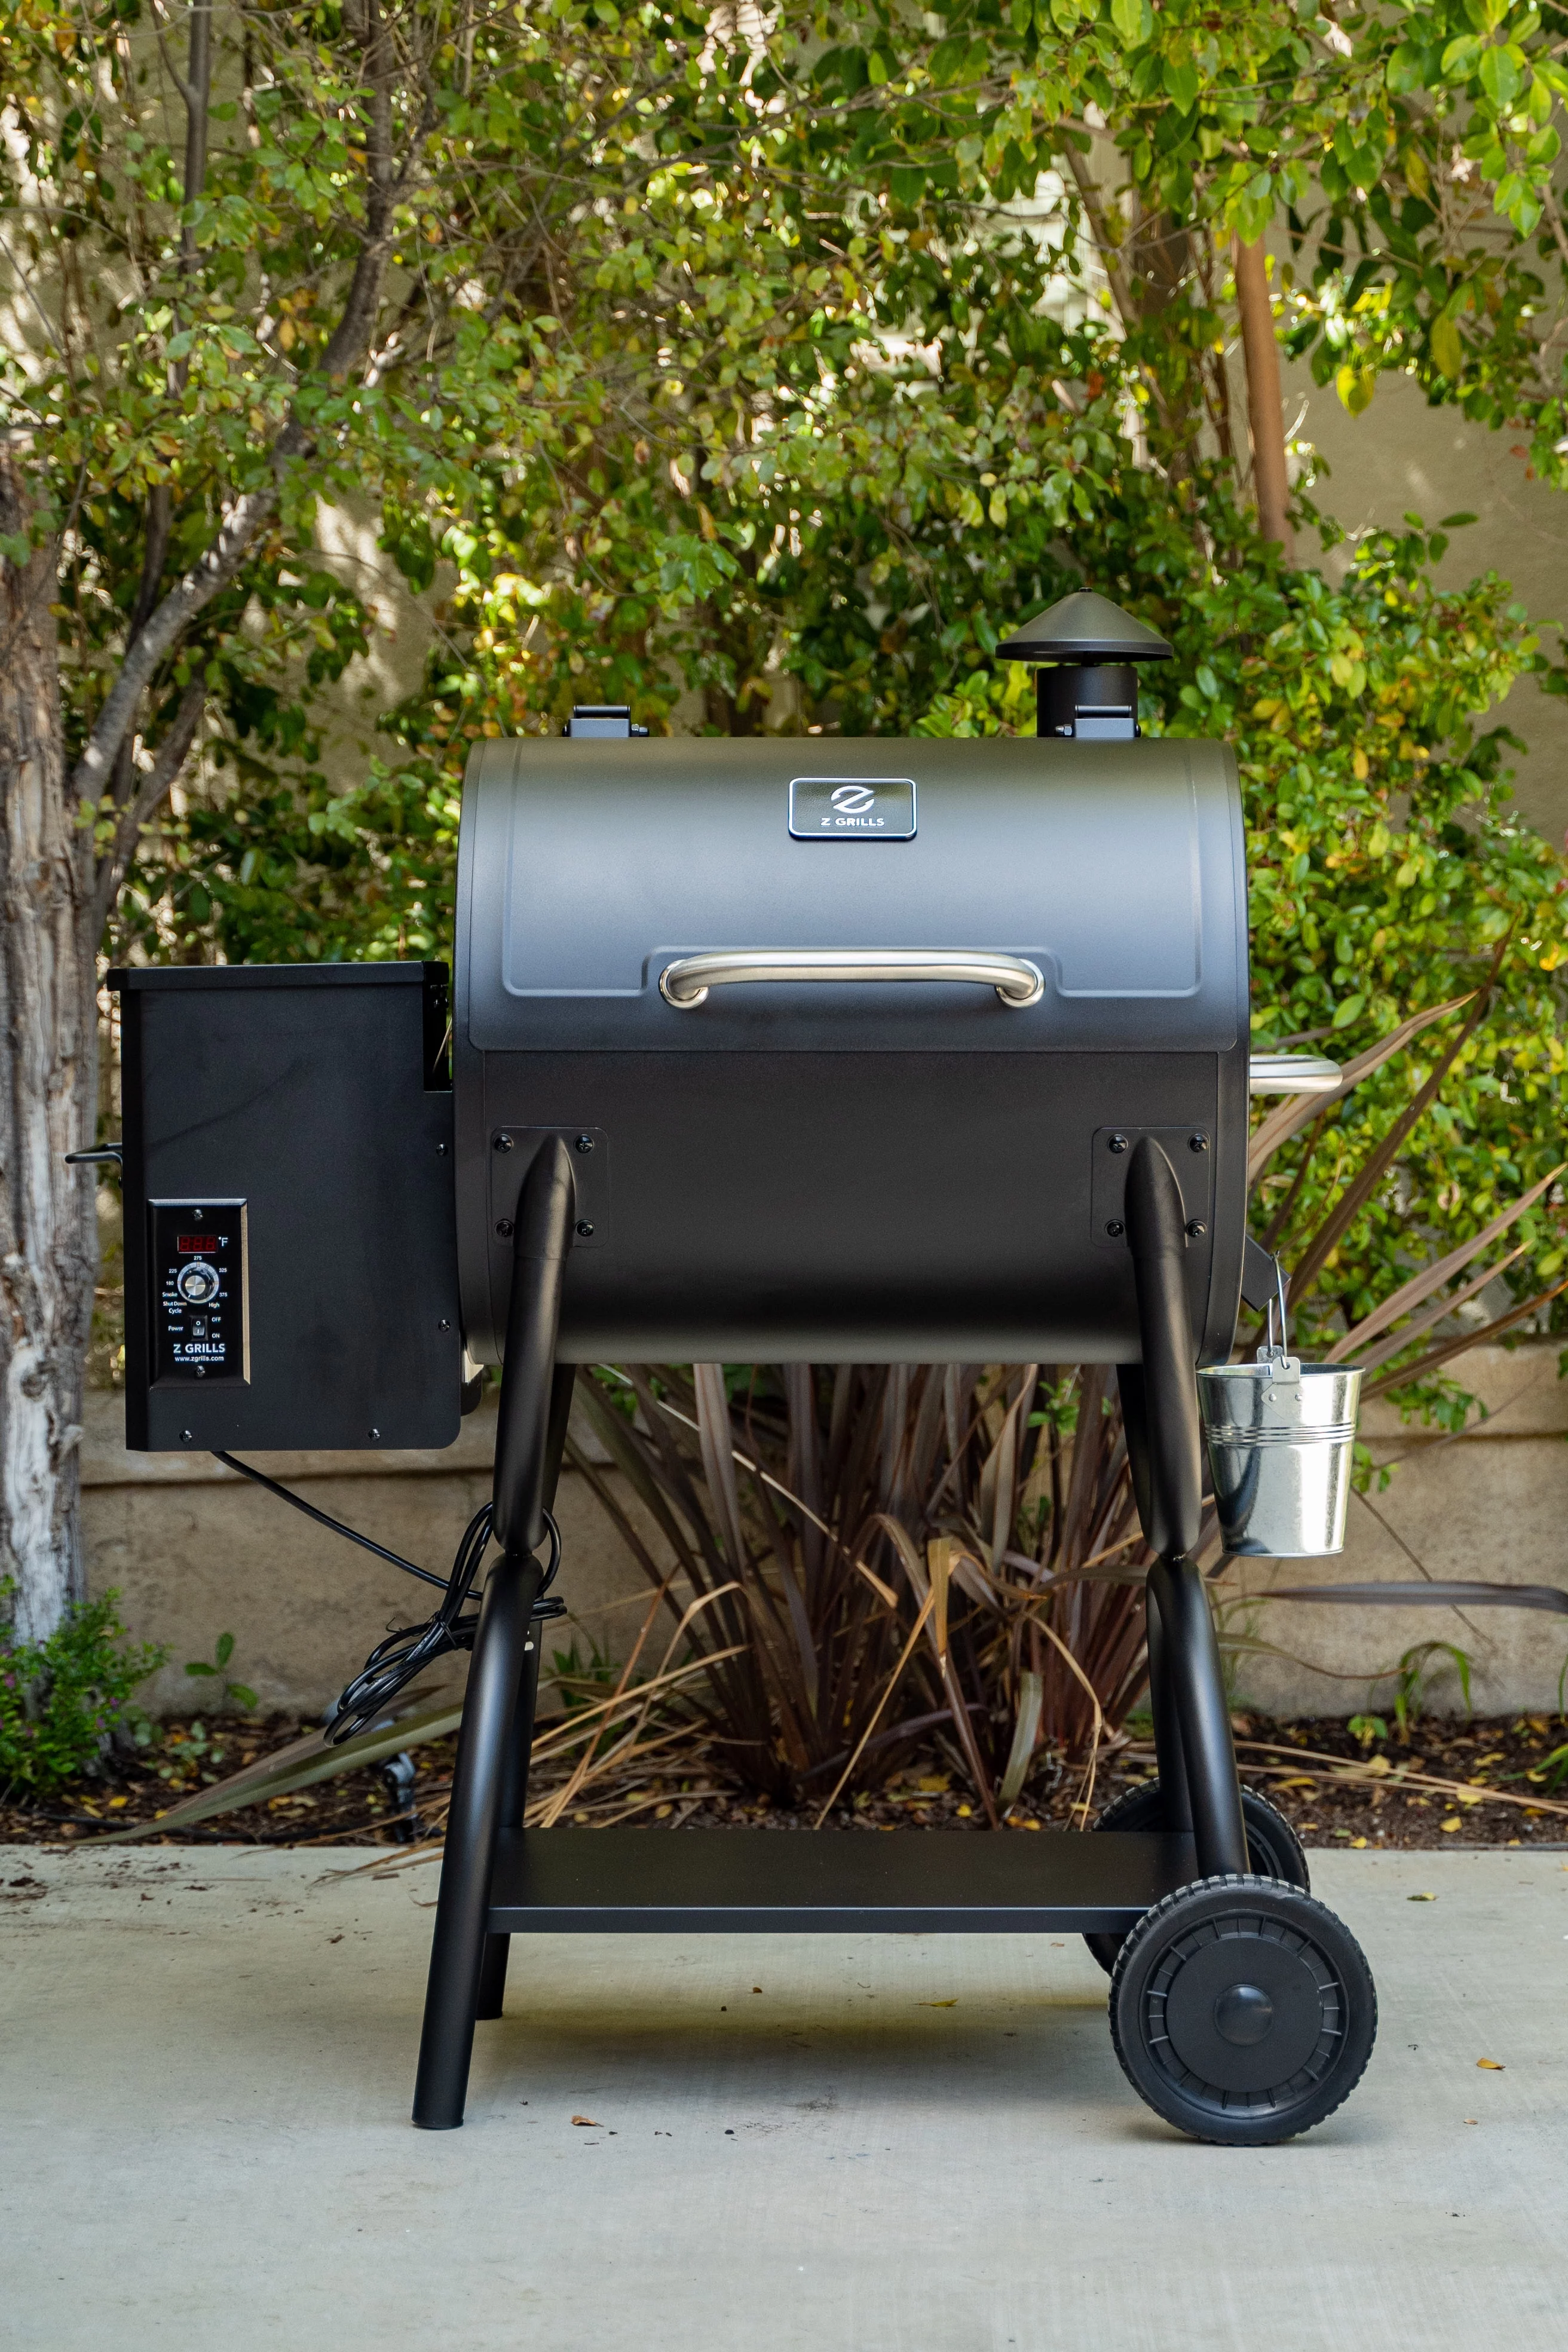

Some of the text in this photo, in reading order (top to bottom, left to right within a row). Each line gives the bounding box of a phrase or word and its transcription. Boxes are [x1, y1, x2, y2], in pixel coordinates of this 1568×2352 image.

[820, 817, 885, 826] Z GRILLS
[173, 1343, 226, 1353] Z GRILLS
